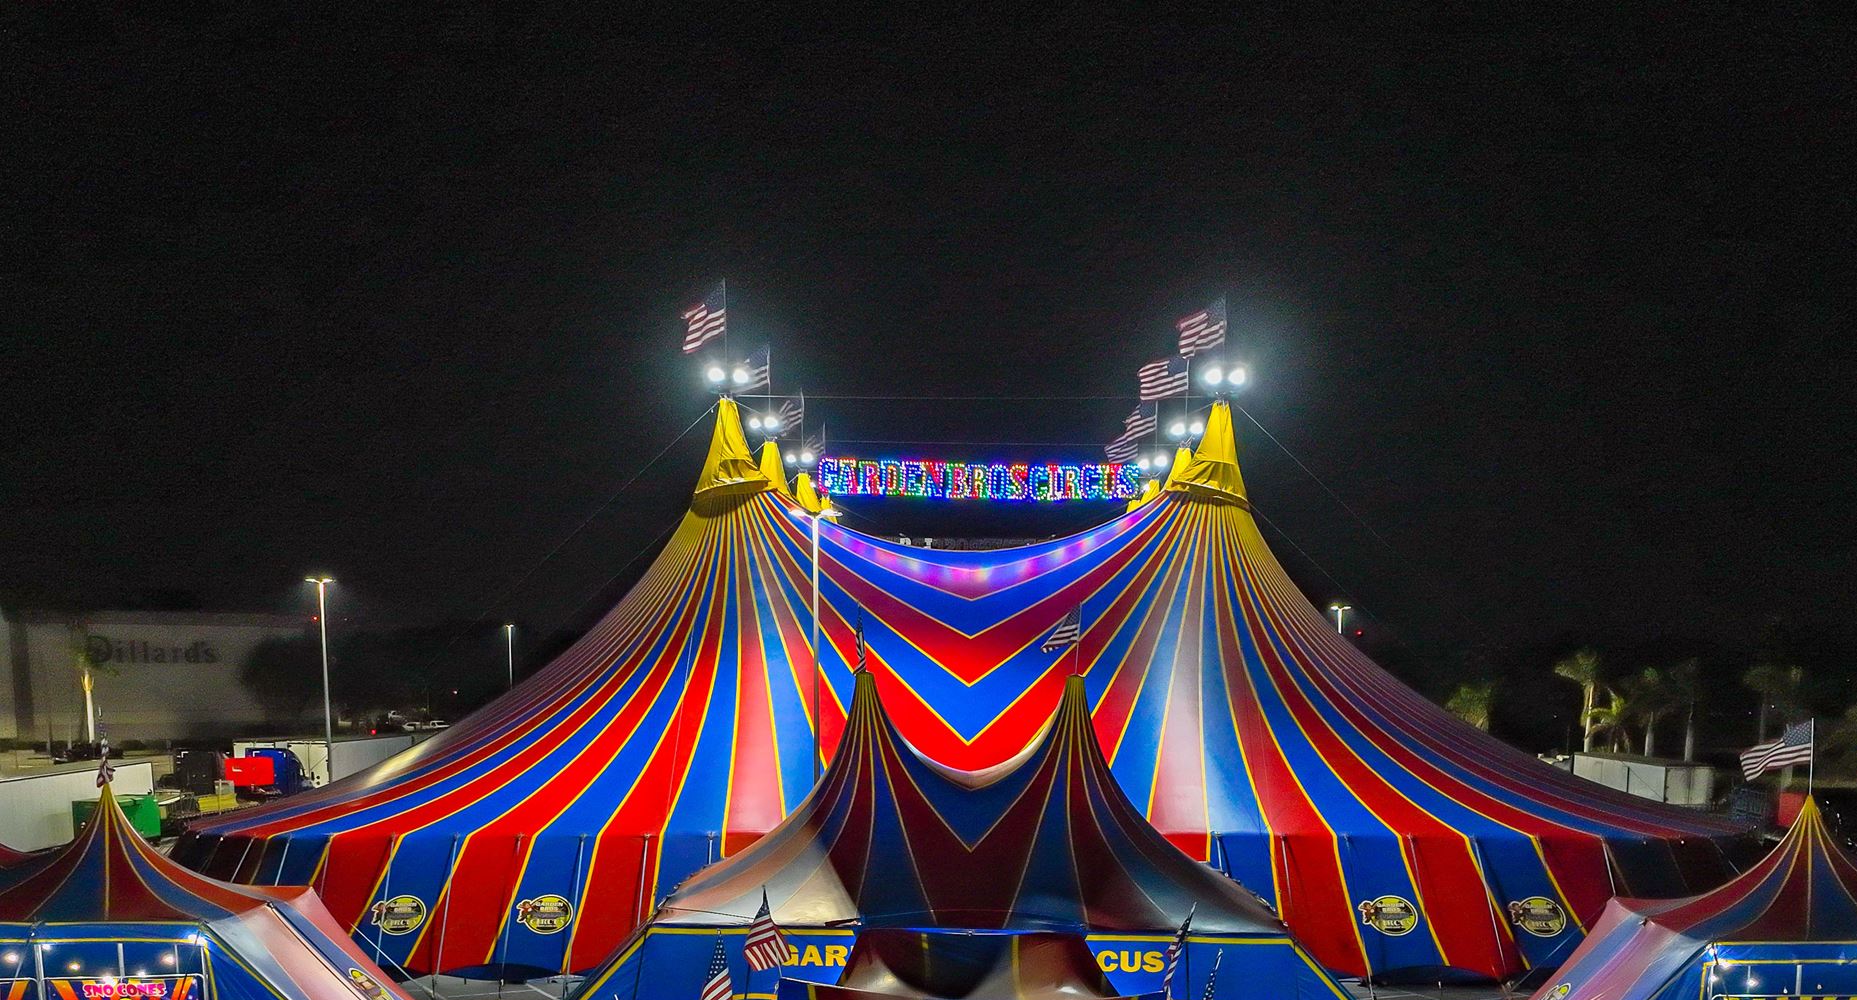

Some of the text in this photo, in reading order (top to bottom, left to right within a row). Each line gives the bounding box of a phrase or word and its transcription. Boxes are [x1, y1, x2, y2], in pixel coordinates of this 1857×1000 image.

[781, 944, 854, 967] GAR
[83, 983, 167, 998] SNO CONES
